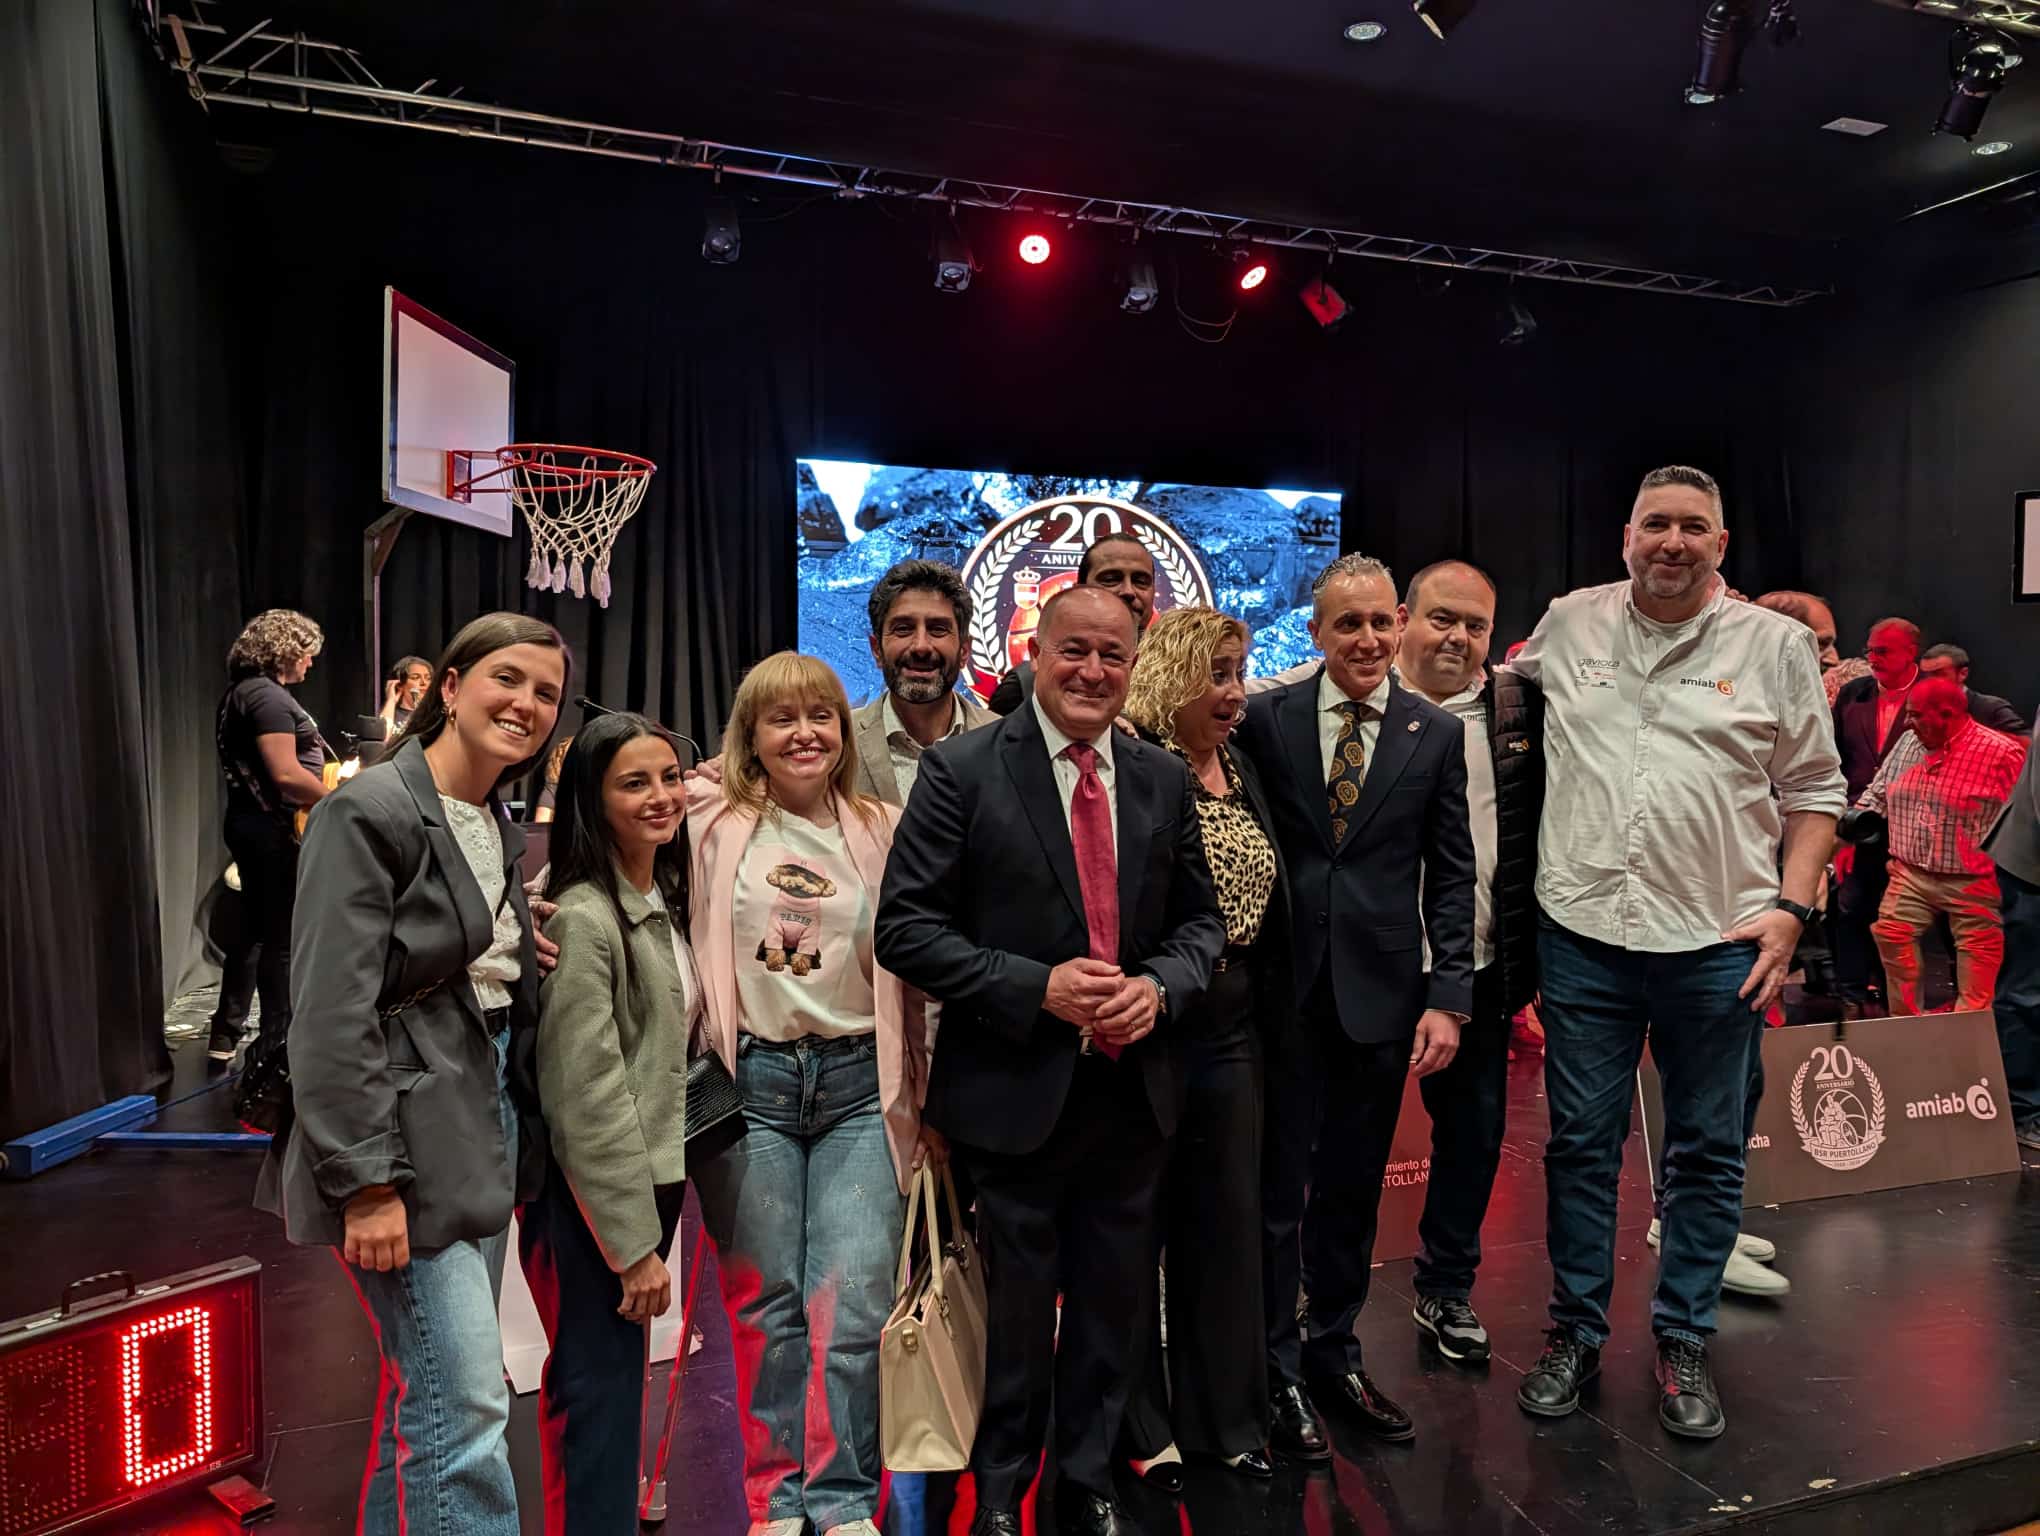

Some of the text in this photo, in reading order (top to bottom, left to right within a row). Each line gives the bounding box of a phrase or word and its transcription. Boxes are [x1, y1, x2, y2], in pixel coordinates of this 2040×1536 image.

[1050, 504, 1121, 550] 20
[1680, 678, 1715, 688] amiab
[1811, 1045, 1853, 1080] 20
[1906, 1092, 1965, 1118] amiab
[1814, 1142, 1876, 1158] BSR PUERTOLLANO
[1382, 1171, 1428, 1188] TOLLAN
